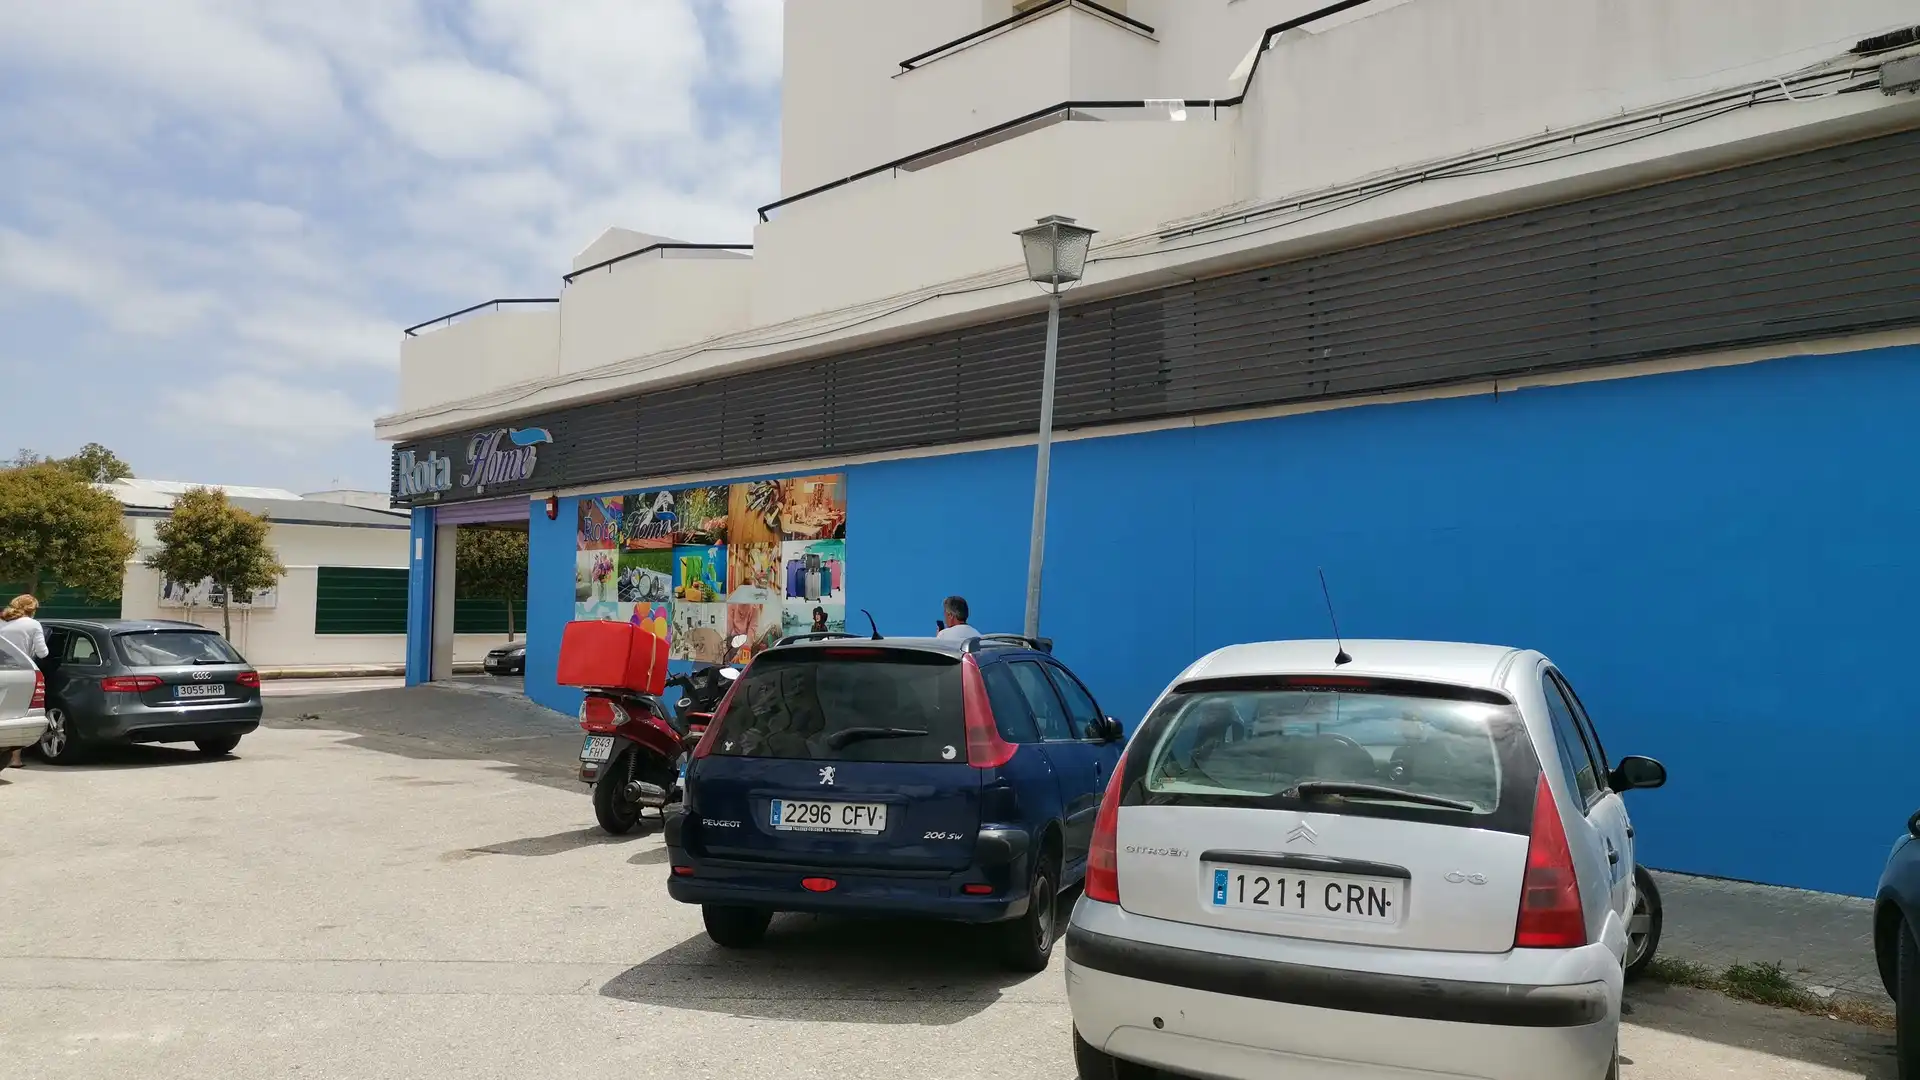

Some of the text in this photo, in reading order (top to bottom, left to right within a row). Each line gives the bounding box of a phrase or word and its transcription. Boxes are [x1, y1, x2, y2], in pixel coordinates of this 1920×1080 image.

[397, 428, 537, 497] Rota Home
[584, 516, 618, 542] Rota
[180, 685, 224, 695] 3055 HRP
[591, 737, 611, 748] 7643
[588, 747, 605, 757] FHY
[785, 803, 878, 826] 2296 CFV
[702, 818, 741, 828] PEUGEOT
[923, 831, 946, 839] 206
[1443, 871, 1489, 886] C3
[1217, 890, 1223, 900] E
[1237, 875, 1387, 917] 1211 CRN
